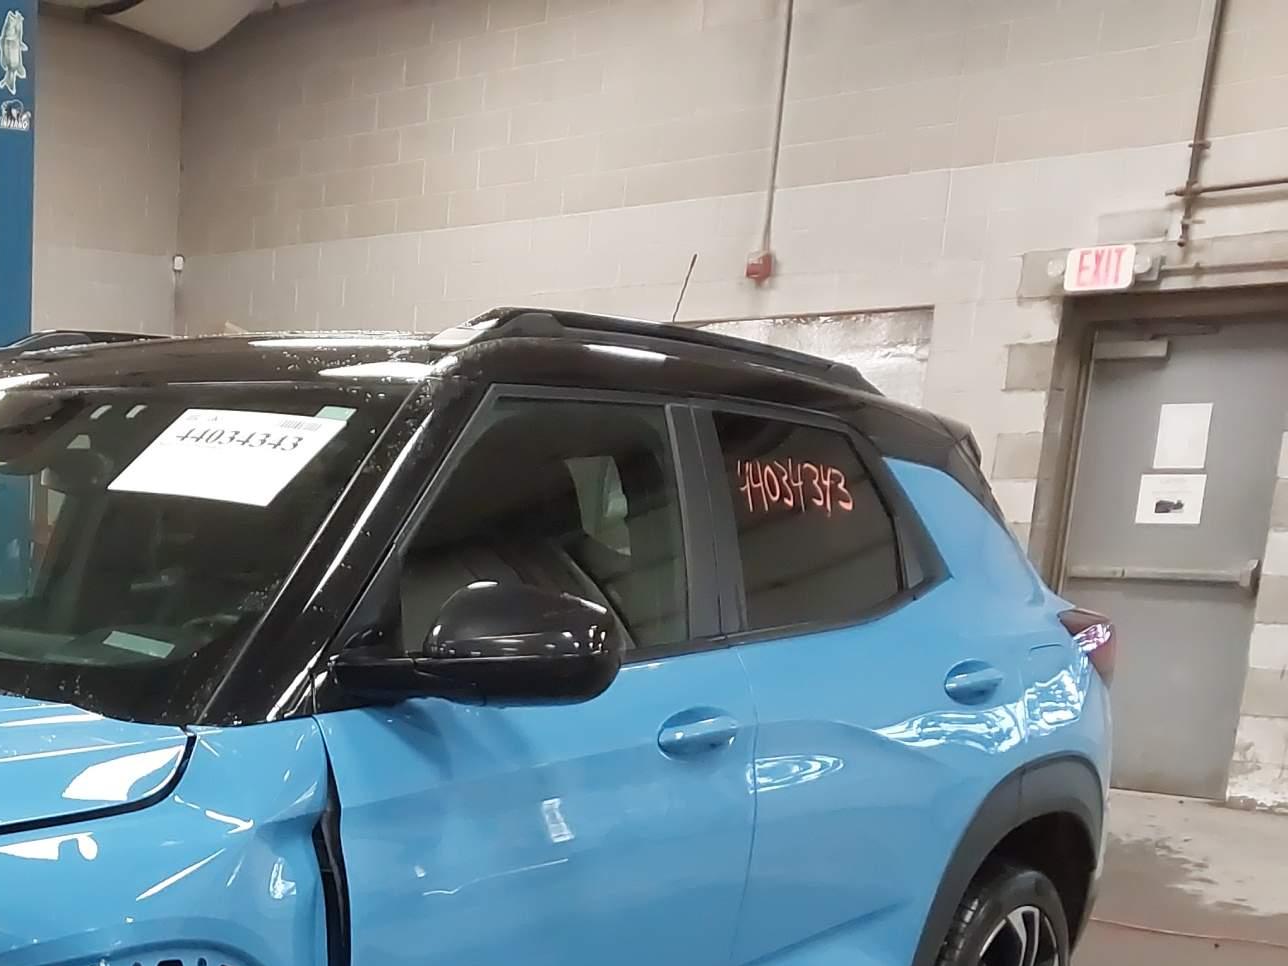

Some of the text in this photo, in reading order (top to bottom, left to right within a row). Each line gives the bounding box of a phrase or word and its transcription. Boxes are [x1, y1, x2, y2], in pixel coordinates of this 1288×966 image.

[1076, 247, 1127, 287] EXIT
[175, 427, 304, 451] 44034343
[737, 457, 853, 517] 44034343
